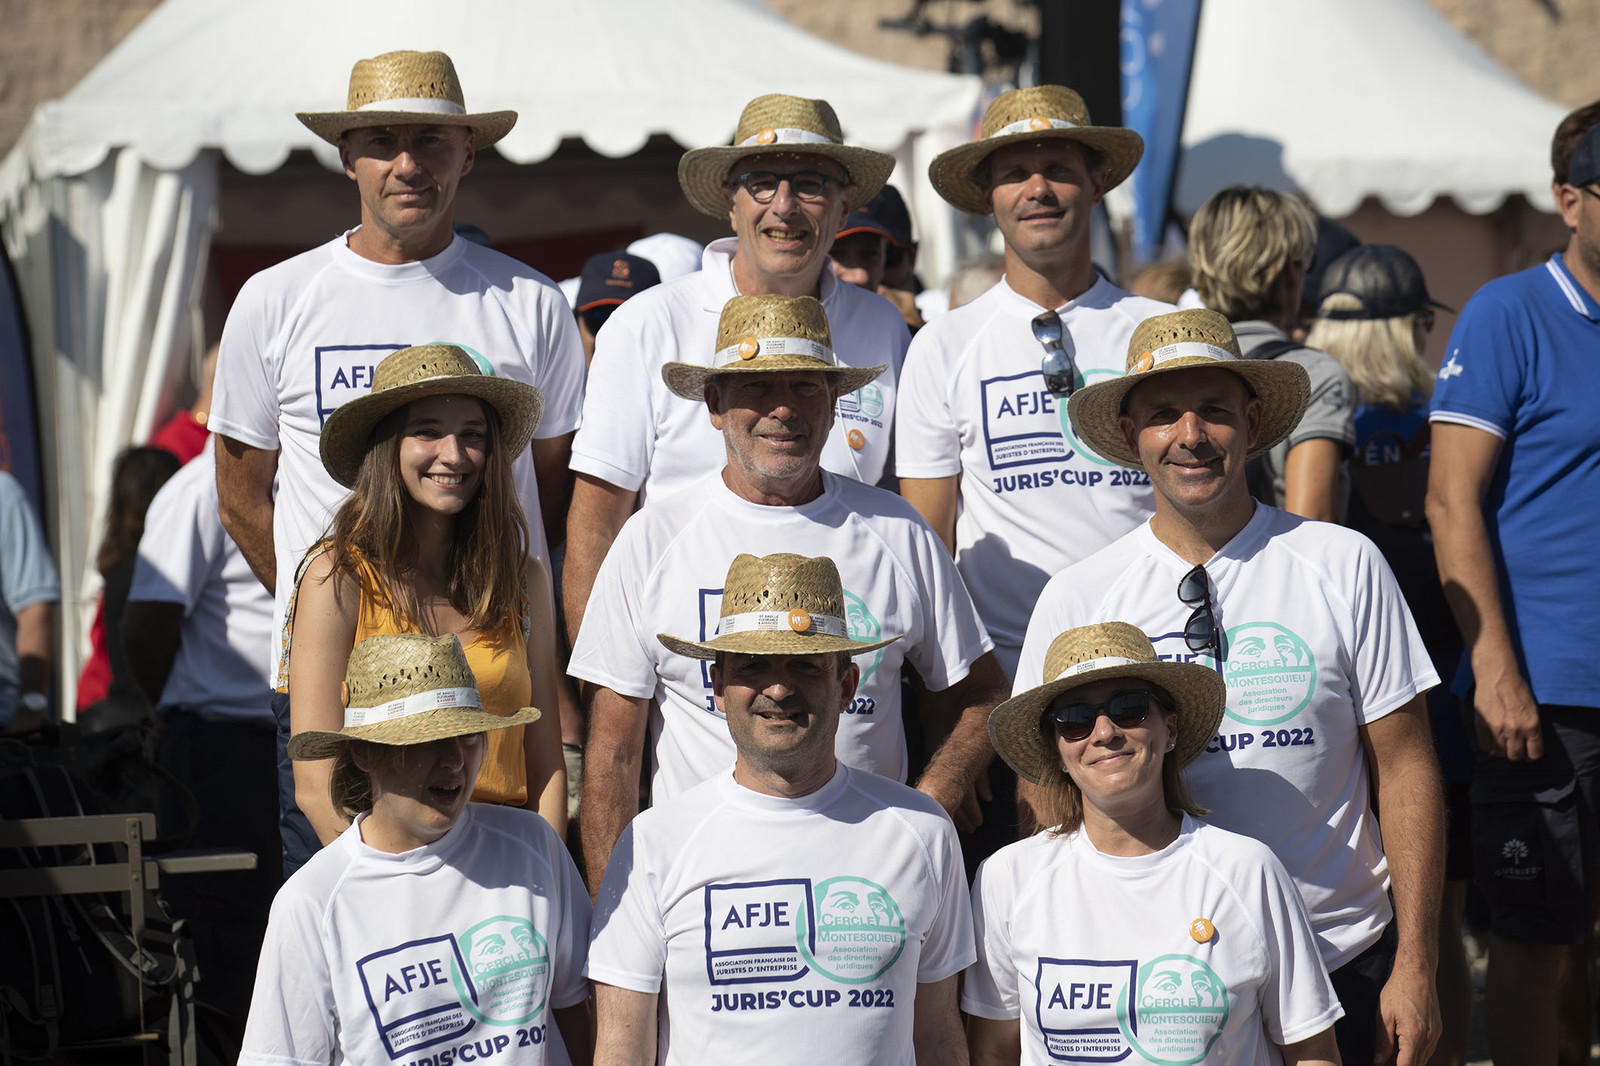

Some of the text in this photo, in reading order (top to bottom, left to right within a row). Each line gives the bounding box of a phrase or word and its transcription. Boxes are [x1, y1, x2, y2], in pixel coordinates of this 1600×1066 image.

[330, 365, 375, 390] AFJ
[996, 390, 1056, 419] AFJE
[994, 443, 1027, 453] ASSOCIATION
[1028, 441, 1053, 449] FRANÇAISE
[995, 447, 1066, 461] JURISTES D'ENTREPRISE
[993, 469, 1151, 494] JURIS'CUP 2022
[1229, 659, 1282, 673] CERCLE
[1226, 673, 1306, 689] MONTESQUIEU
[1242, 687, 1288, 698] Association
[840, 697, 876, 715] 022
[1238, 694, 1294, 707] des directeurs
[1247, 703, 1286, 715] juridiques
[1260, 728, 1314, 748] 2022
[721, 901, 790, 931] AFJE
[821, 913, 875, 926] CERCLE
[817, 930, 897, 944] MONTESQUIEU
[832, 945, 878, 953] Association
[474, 952, 525, 974] CERCLE
[714, 959, 753, 968] ASSOCIATION
[753, 956, 786, 965] FRANÇAISE
[843, 953, 882, 961] directeurs
[716, 964, 798, 976] JURISTES D'ENTREPRISE
[835, 962, 874, 970] juridiques
[385, 959, 448, 1002] AFJE
[477, 965, 546, 992] MONTESQUIEU
[492, 982, 534, 998] Association
[1048, 982, 1113, 1010] AFJE
[489, 1000, 502, 1008] des
[711, 989, 895, 1012] JURIS'CUP 2022
[1142, 995, 1199, 1008] CERCLE
[424, 1015, 453, 1028] FRANÇAISE
[452, 1012, 463, 1020] DES
[1138, 1014, 1218, 1025] MONTESQUIEU
[394, 1019, 465, 1047] JURISTES D'ENTREPRISE
[1164, 1036, 1203, 1044] directeurs
[1049, 1044, 1075, 1052] JURISTES
[1156, 1045, 1195, 1053] juridiques
